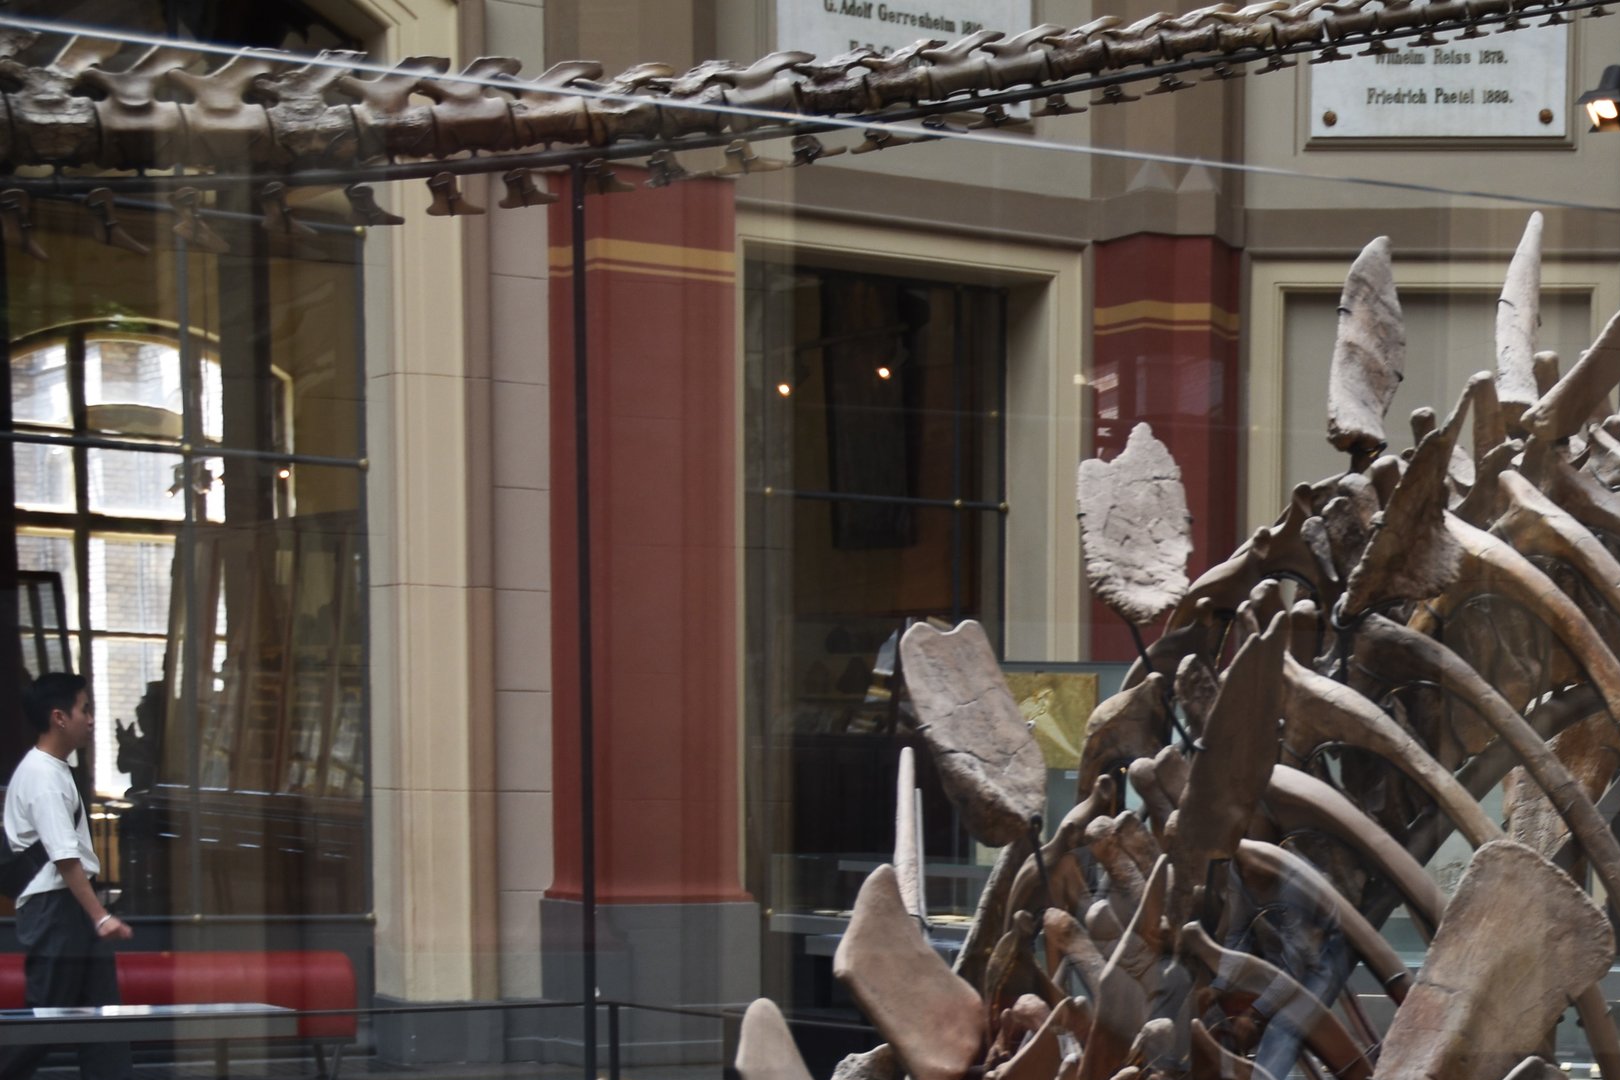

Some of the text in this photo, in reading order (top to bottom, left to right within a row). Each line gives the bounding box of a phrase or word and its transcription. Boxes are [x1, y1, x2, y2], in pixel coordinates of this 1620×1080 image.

[839, 0, 873, 19] Adolf
[878, 4, 956, 33] Gerresheim
[1375, 49, 1426, 65] Wilhelm
[1433, 49, 1472, 65] Reiss
[1366, 87, 1427, 105] Friedrich
[1434, 88, 1475, 104] Paetel
